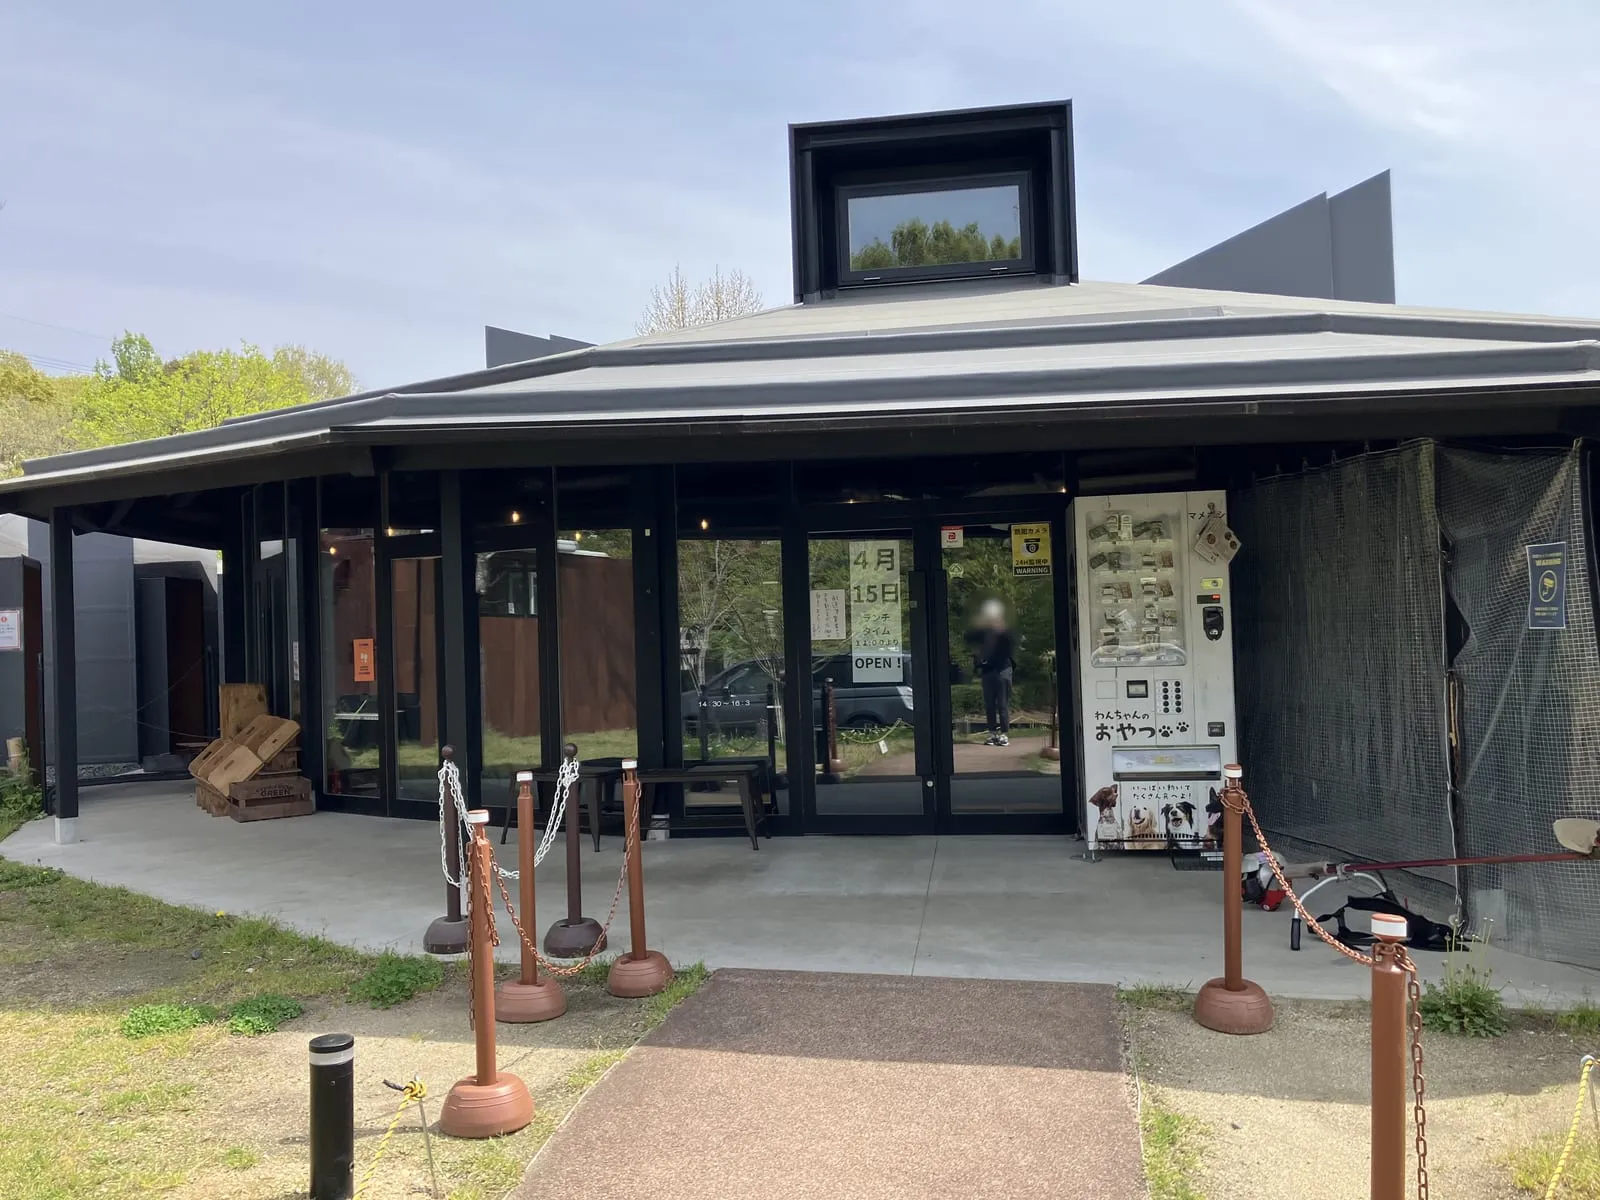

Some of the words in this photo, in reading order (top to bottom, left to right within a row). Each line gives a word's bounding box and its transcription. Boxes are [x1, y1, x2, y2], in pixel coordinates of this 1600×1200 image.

[1015, 567, 1049, 575] WARNING
[853, 583, 899, 603] 15日
[863, 613, 891, 623] ランチ
[863, 626, 891, 636] タイム
[1095, 709, 1150, 721] わんちゃんの
[1095, 722, 1156, 741] おやつ
[260, 787, 291, 797] GREEN
